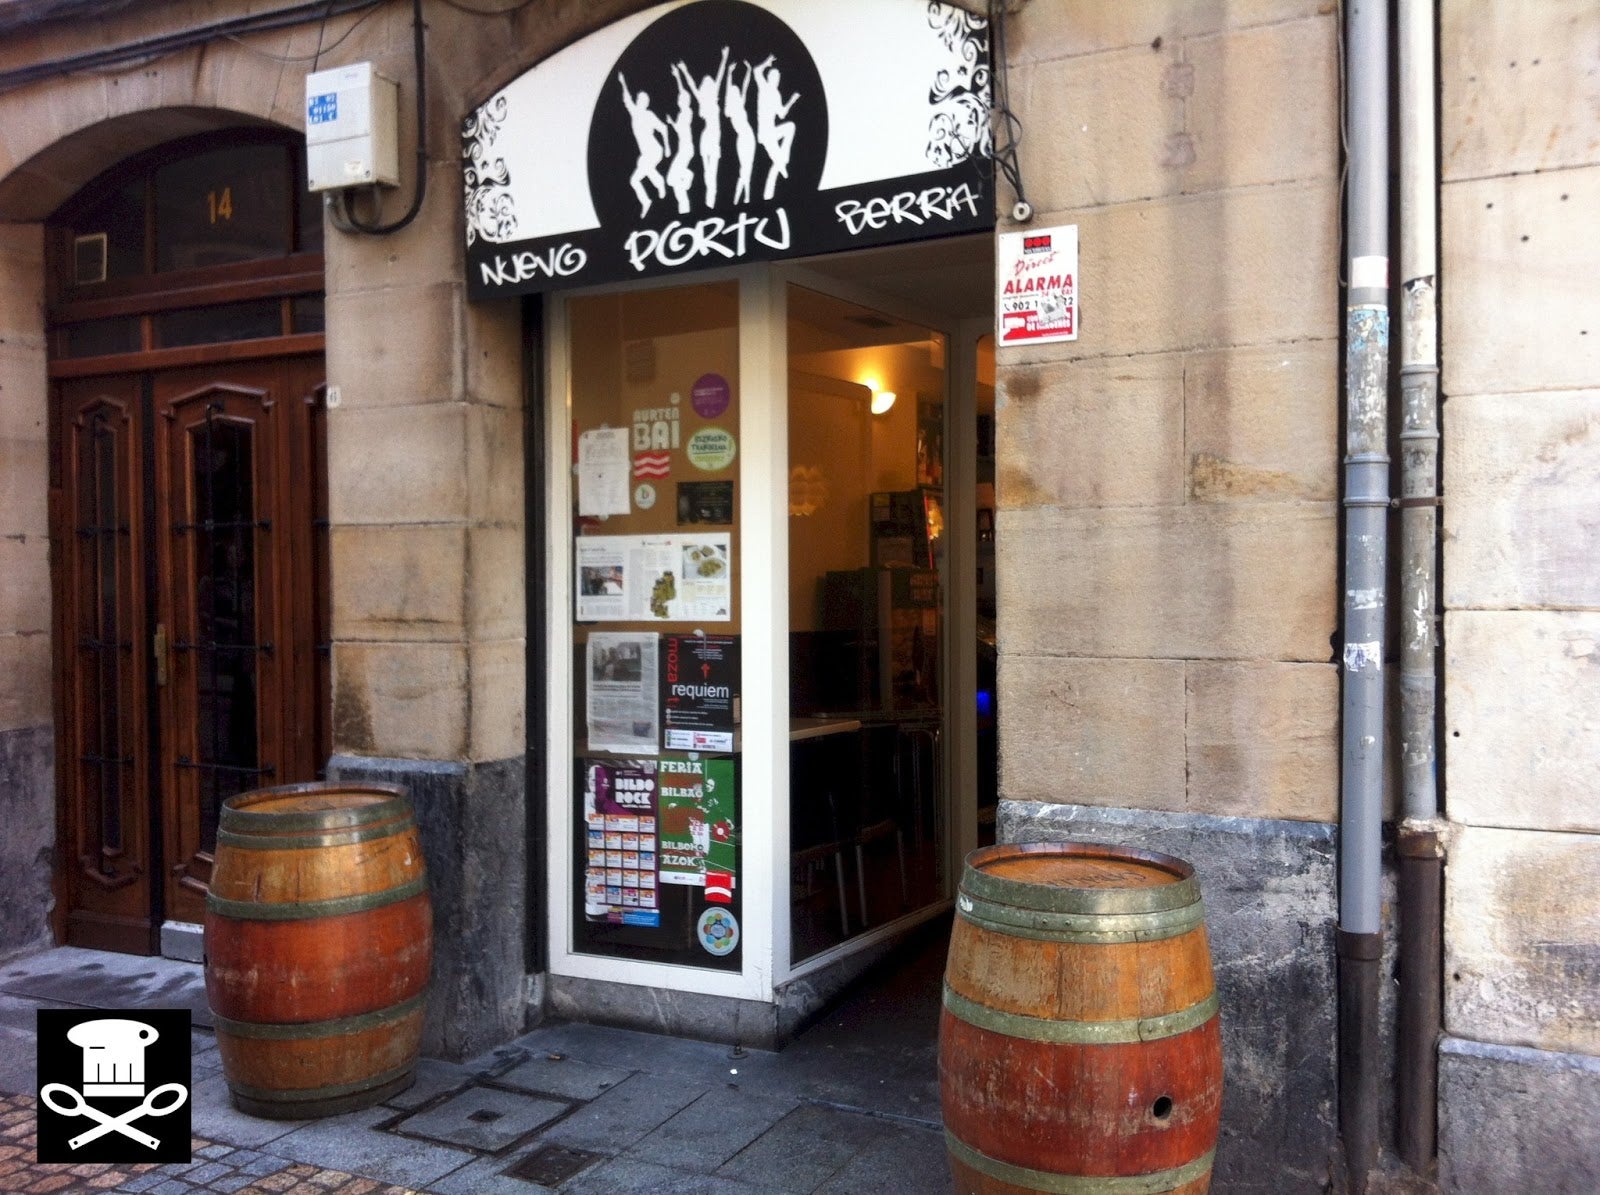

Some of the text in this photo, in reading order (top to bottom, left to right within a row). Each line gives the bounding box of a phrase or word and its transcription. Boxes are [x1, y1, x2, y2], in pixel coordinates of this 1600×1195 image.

[207, 187, 233, 224] 14
[624, 207, 790, 272] PORTU
[1003, 274, 1073, 295] ALARMA
[1012, 301, 1030, 312] 902
[671, 682, 730, 700] requiem
[660, 761, 703, 775] FERIA
[615, 778, 655, 792] BILBO
[615, 791, 651, 805] ROCK
[660, 787, 703, 798] BILBAO
